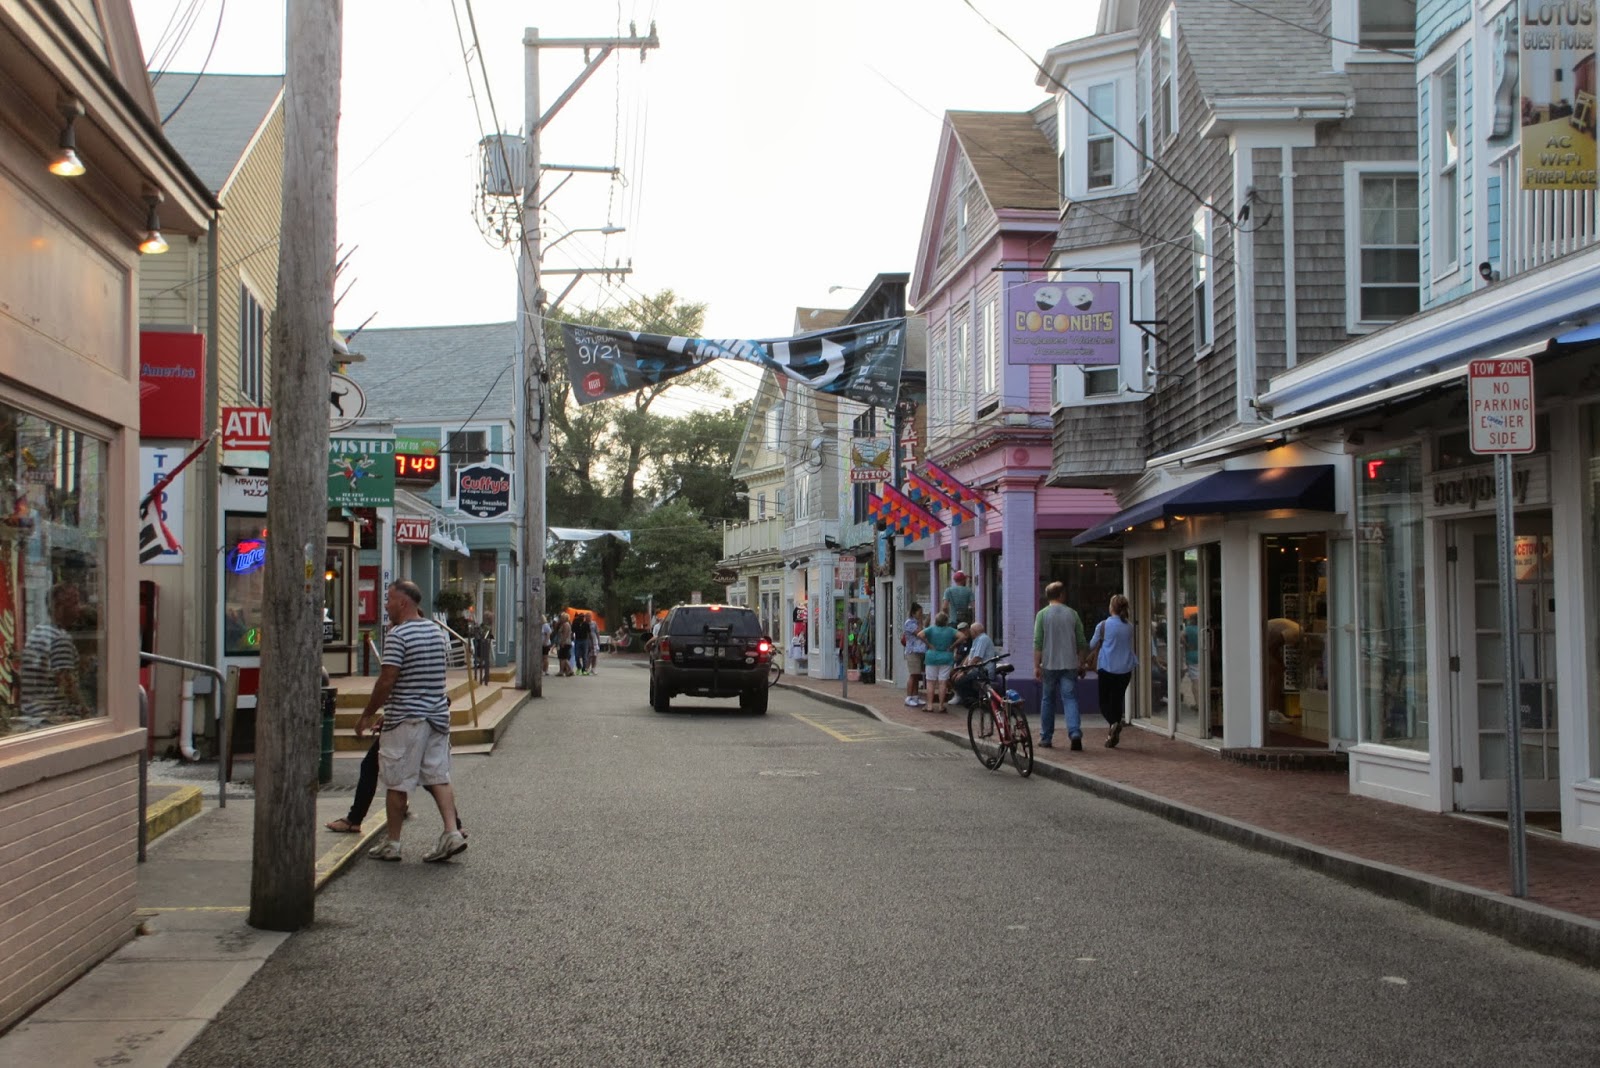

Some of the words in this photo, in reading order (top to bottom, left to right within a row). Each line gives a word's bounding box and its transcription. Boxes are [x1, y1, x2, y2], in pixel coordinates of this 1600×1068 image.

[1524, 1, 1592, 26] LOTUS
[1523, 31, 1556, 50] GUEST
[1559, 29, 1594, 50] HOUSE
[1546, 135, 1572, 149] AC
[1525, 167, 1597, 185] FIREPLACE
[1015, 310, 1113, 333] COCONUTS
[578, 344, 620, 365] 9/21
[142, 363, 196, 379] America
[1472, 363, 1495, 375] TOW
[1500, 361, 1528, 375] ZONE
[1493, 382, 1510, 394] NO
[1474, 398, 1529, 411] PARKING
[224, 411, 271, 437] ATM
[1489, 432, 1517, 444] SIDE
[328, 440, 395, 455] WISTED
[461, 475, 510, 495] Cuffy's
[397, 523, 429, 539] ATM
